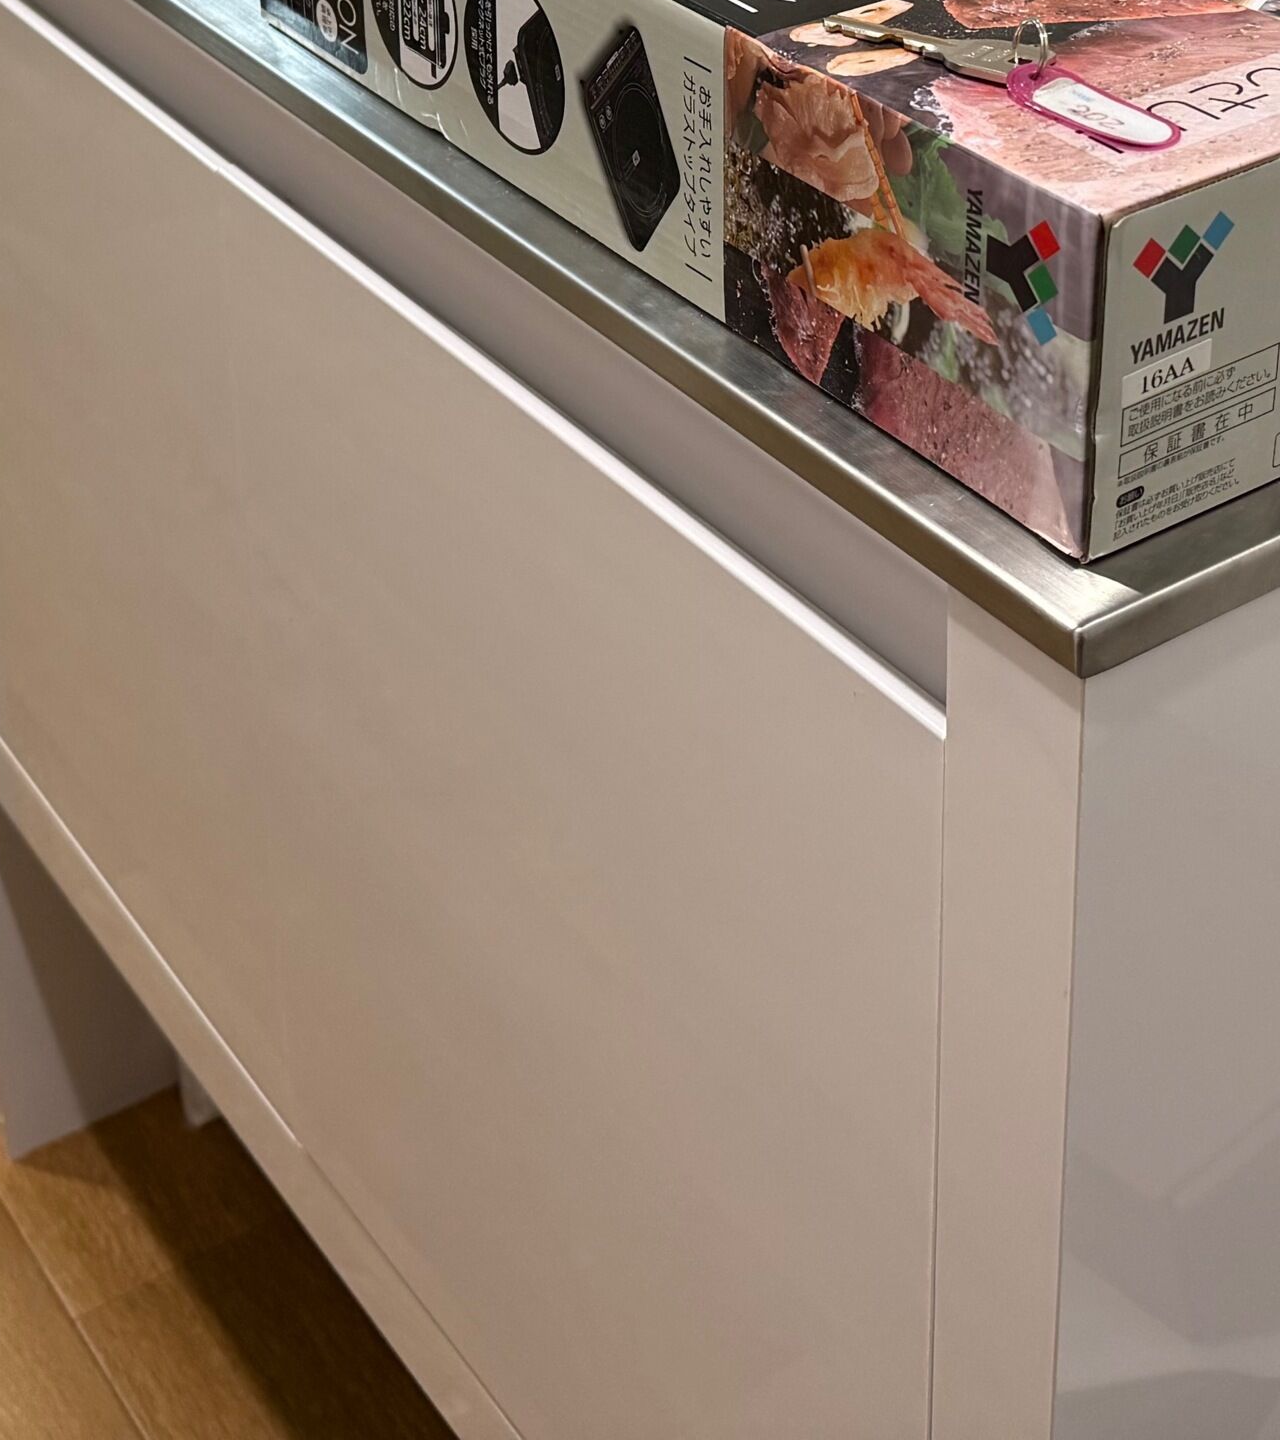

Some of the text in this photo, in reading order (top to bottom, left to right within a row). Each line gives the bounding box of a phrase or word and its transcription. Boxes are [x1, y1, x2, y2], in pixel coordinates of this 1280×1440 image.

[417, 4, 429, 53] 24cm
[680, 69, 698, 258] ガラストップタイプ
[697, 82, 713, 262] お手入れしやすい
[963, 182, 983, 306] YAMAZEN
[1129, 306, 1225, 366] YAMAZEN
[1127, 365, 1272, 439] 取扱説明書をお読みください。
[1128, 363, 1236, 422] ご使用になる前に必ず
[1140, 354, 1195, 395] 16AA
